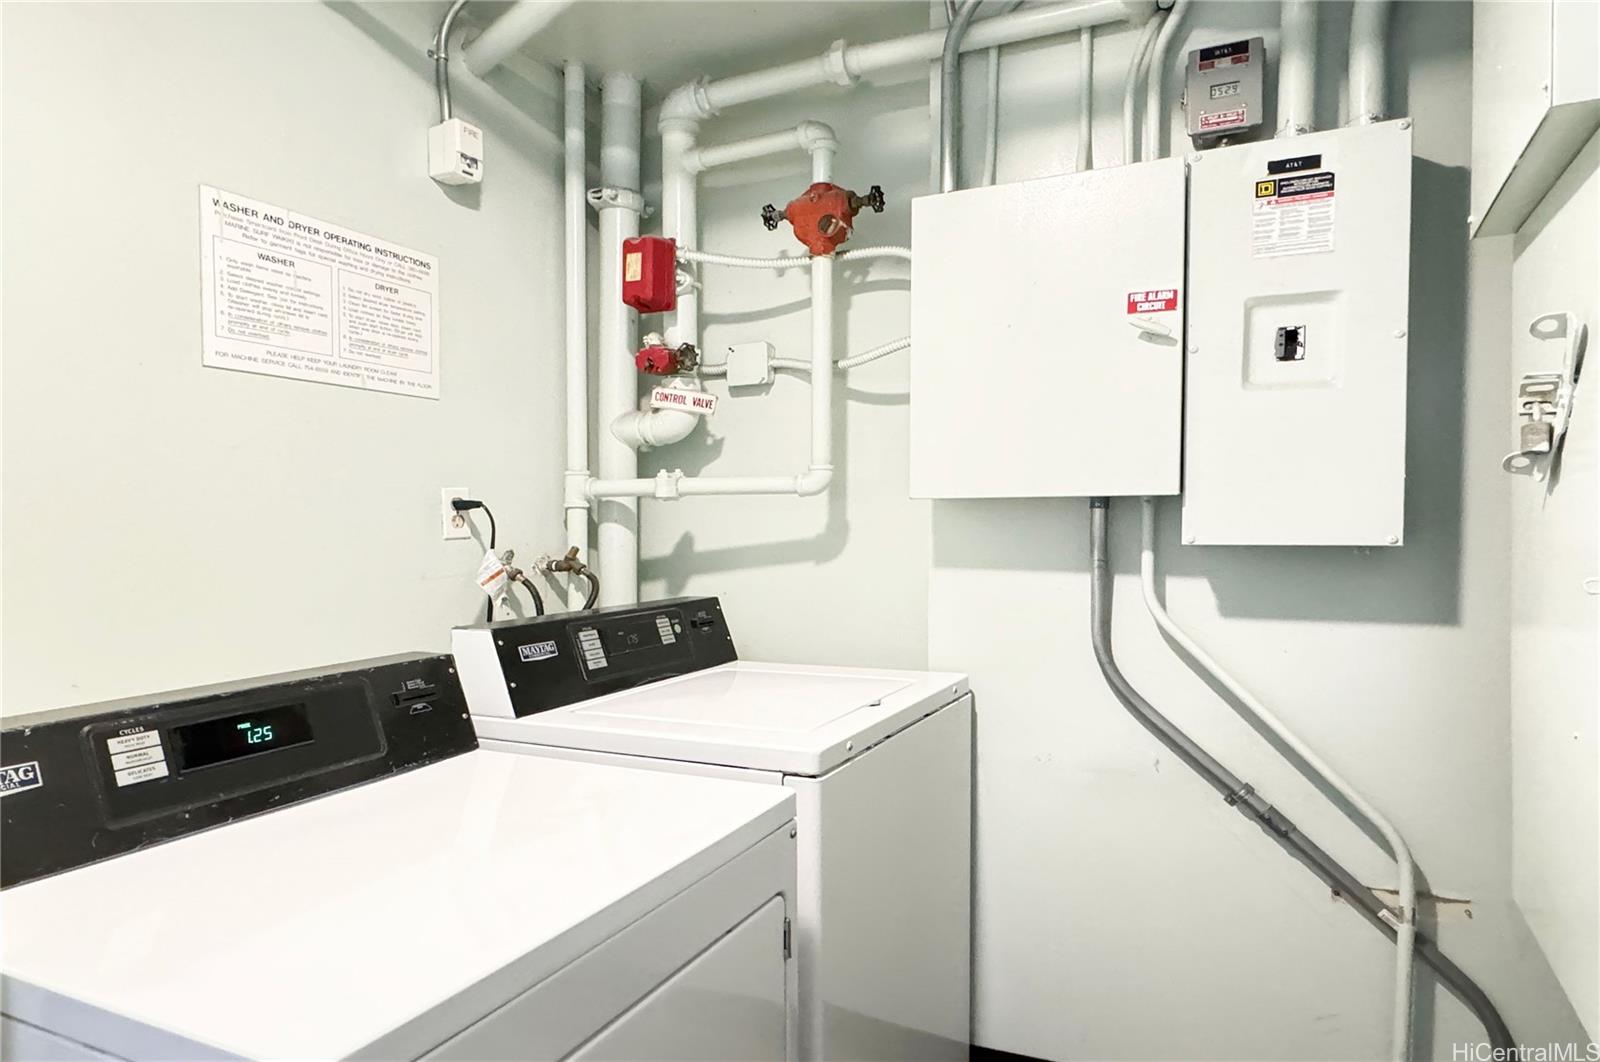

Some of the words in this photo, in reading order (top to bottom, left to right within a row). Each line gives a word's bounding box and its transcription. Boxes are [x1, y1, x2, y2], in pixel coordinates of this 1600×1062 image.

[212, 196, 258, 219] WASHER
[262, 212, 284, 226] AND
[288, 219, 319, 236] DRYER
[323, 230, 371, 251] OPERATING
[374, 245, 431, 269] INSTRUCTIONS
[257, 252, 294, 268] WASHER
[375, 282, 398, 294] DRYER
[1130, 293, 1146, 302] FIRE
[1148, 291, 1174, 301] ALARM
[1137, 301, 1166, 311] CIRCUIT
[655, 391, 687, 405] CONTROL
[692, 397, 713, 409] VALVE
[522, 643, 555, 656] MAYTAG
[119, 726, 145, 736] CYCLES
